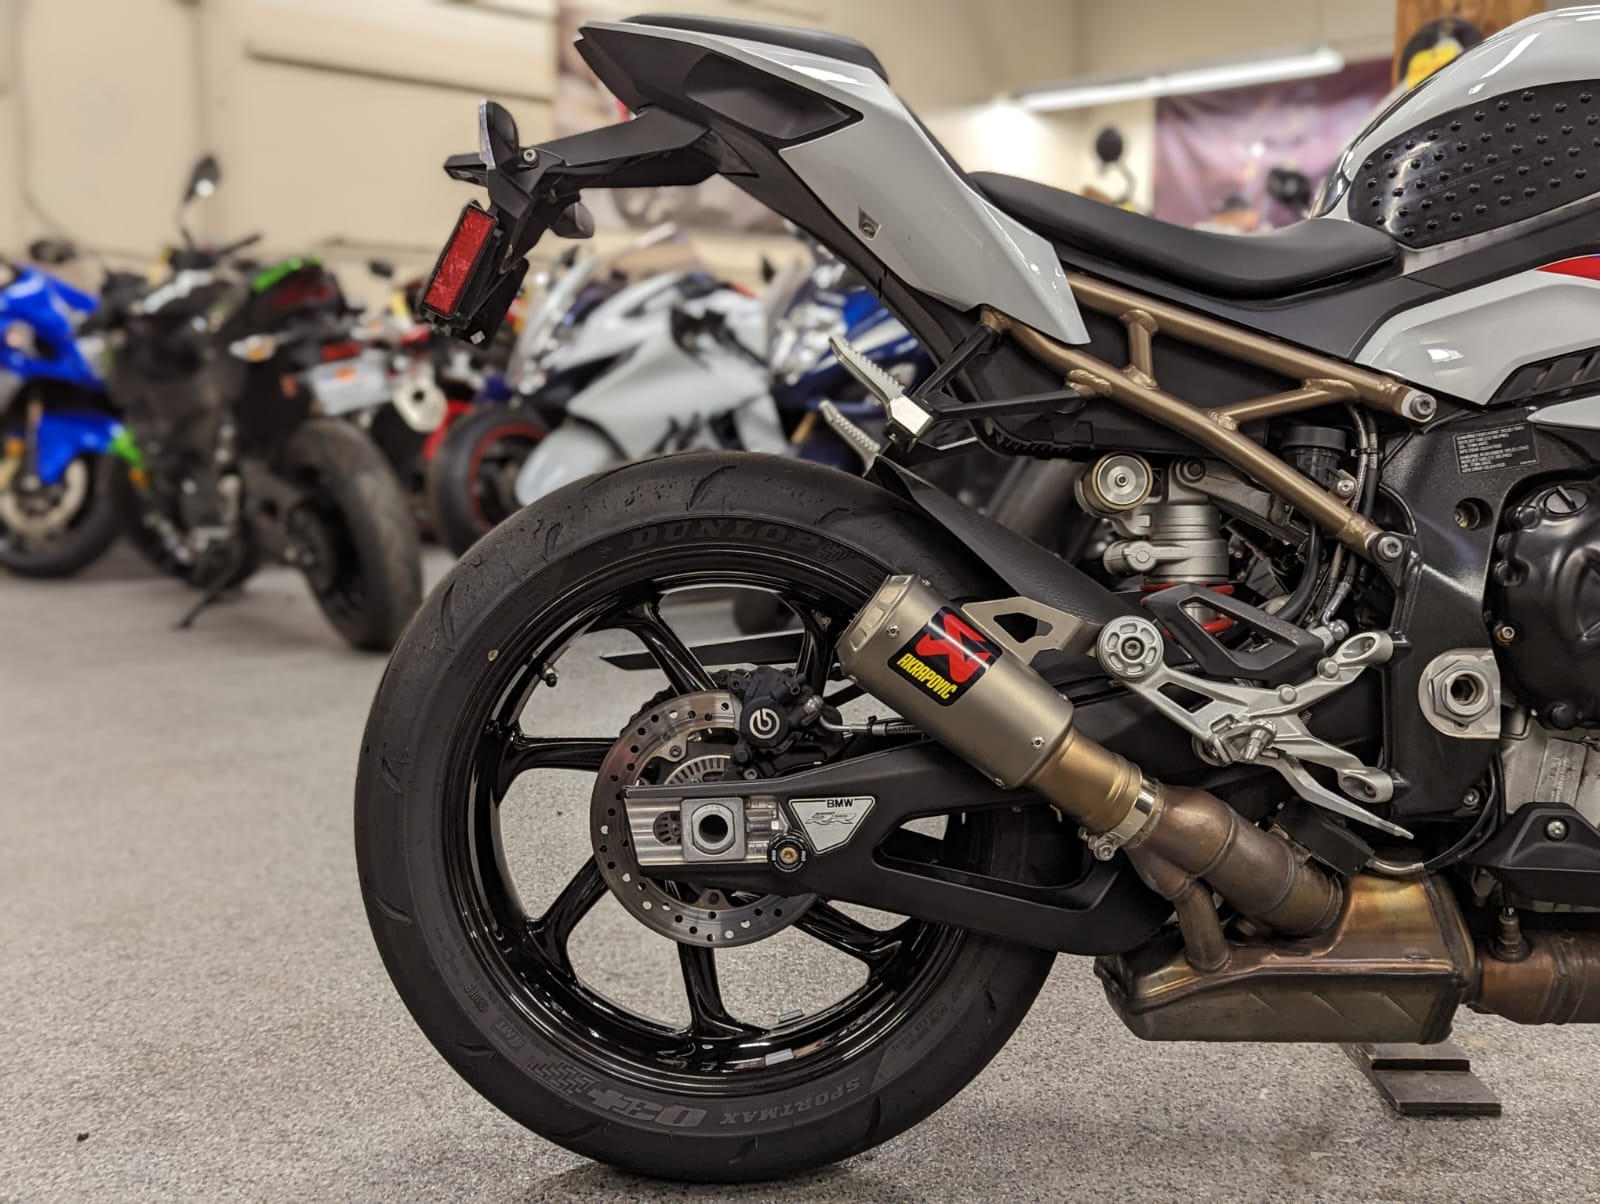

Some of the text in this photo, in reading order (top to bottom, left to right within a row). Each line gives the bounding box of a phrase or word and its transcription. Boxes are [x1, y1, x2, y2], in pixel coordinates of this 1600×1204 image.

[629, 517, 822, 549] DUNLOP
[826, 799, 854, 809] BMW
[719, 1077, 860, 1125] SPORTMAX
